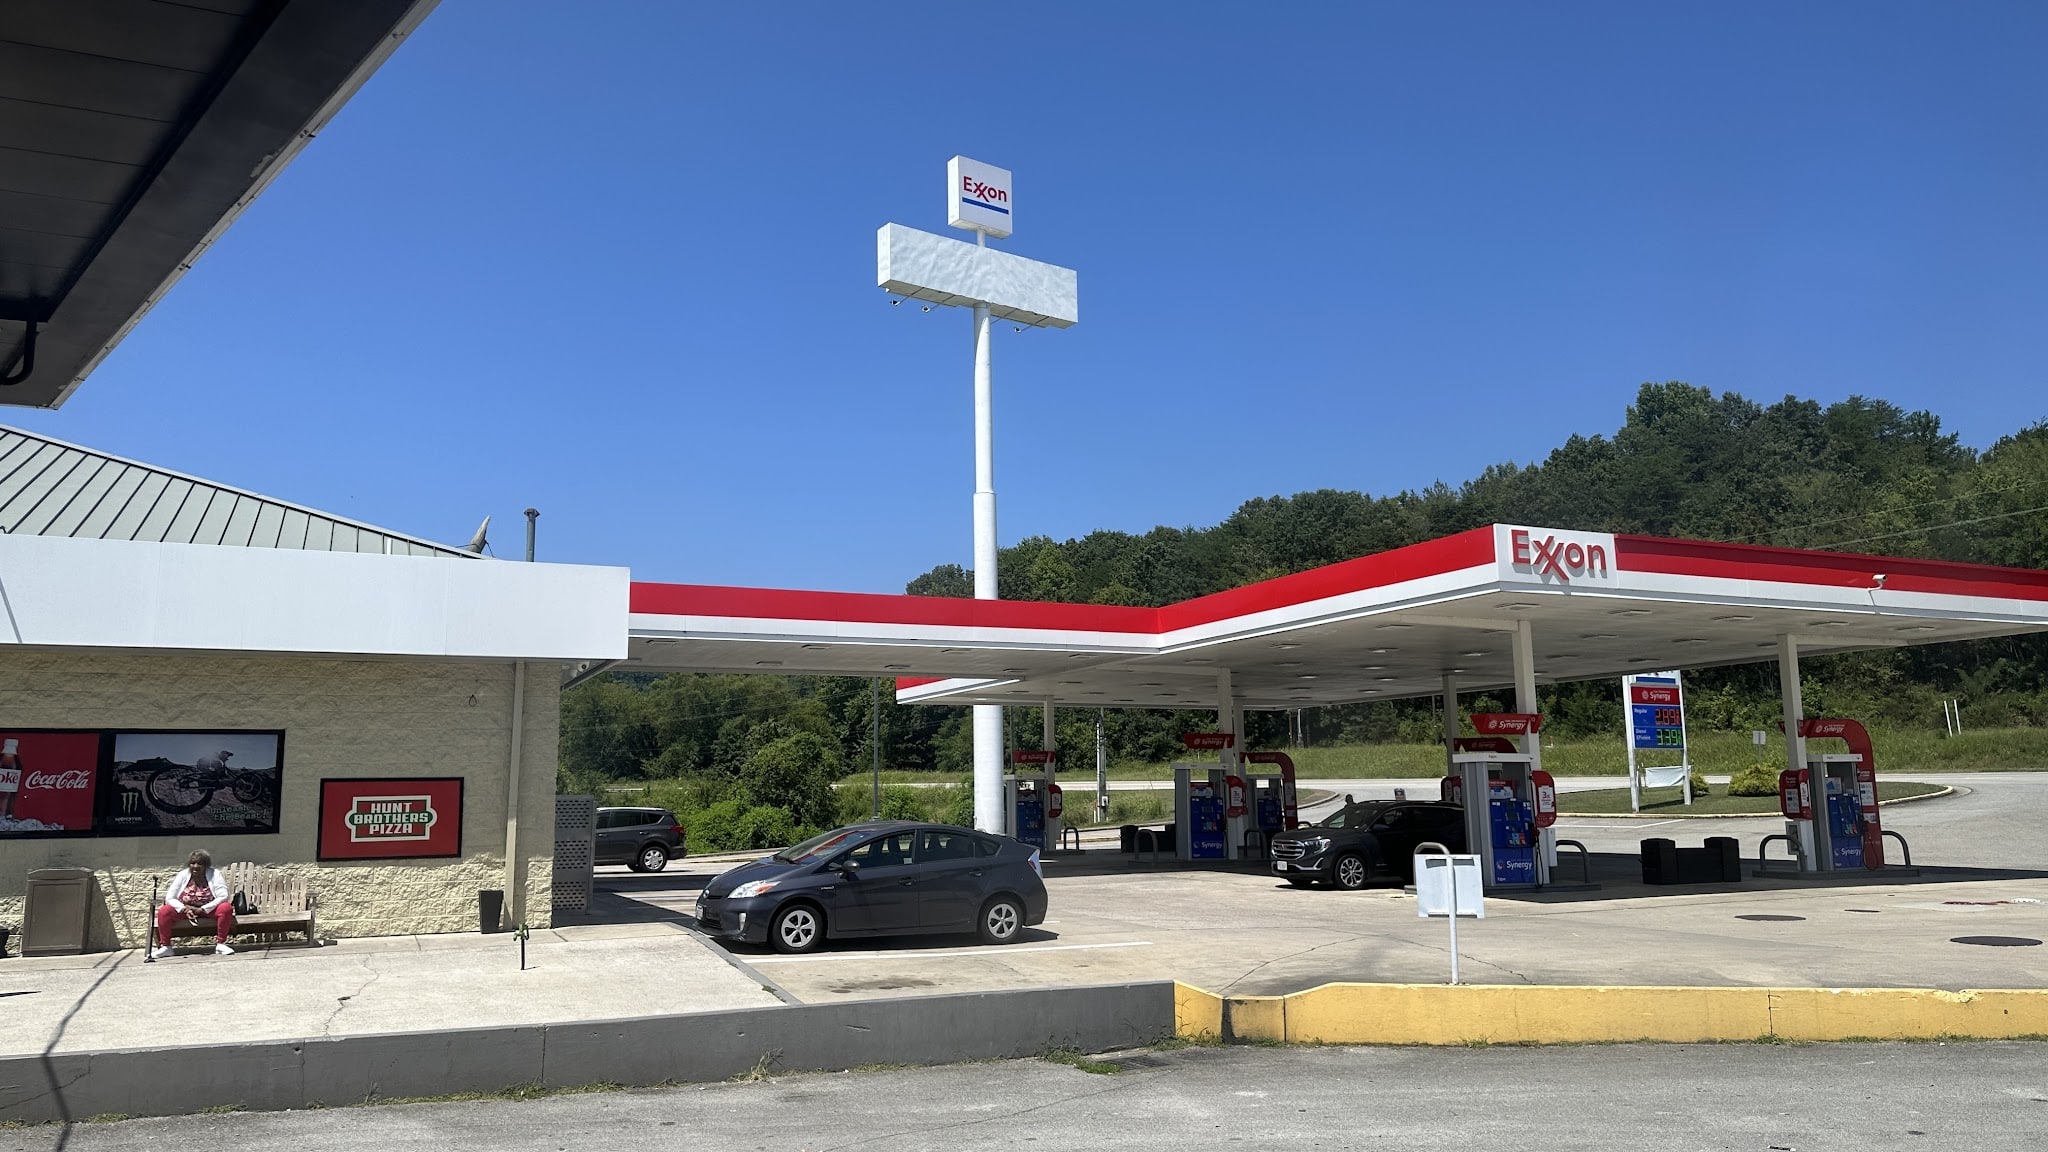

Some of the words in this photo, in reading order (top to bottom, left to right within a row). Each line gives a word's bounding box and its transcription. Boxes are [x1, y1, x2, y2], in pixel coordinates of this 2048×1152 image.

[963, 175, 1007, 202] Exxon
[1511, 529, 1607, 581] Exxon
[1650, 691, 1671, 702] Synergy
[1498, 720, 1526, 730] Synergy
[1823, 725, 1845, 734] Synergy
[25, 770, 92, 790] Coca-Cola
[371, 802, 412, 814] HUNT
[353, 812, 430, 825] BROTHERS
[369, 824, 413, 835] PIZZA
[1201, 841, 1223, 850] Synergy
[1841, 847, 1862, 856] Synergy
[1506, 860, 1533, 871] Synergy
